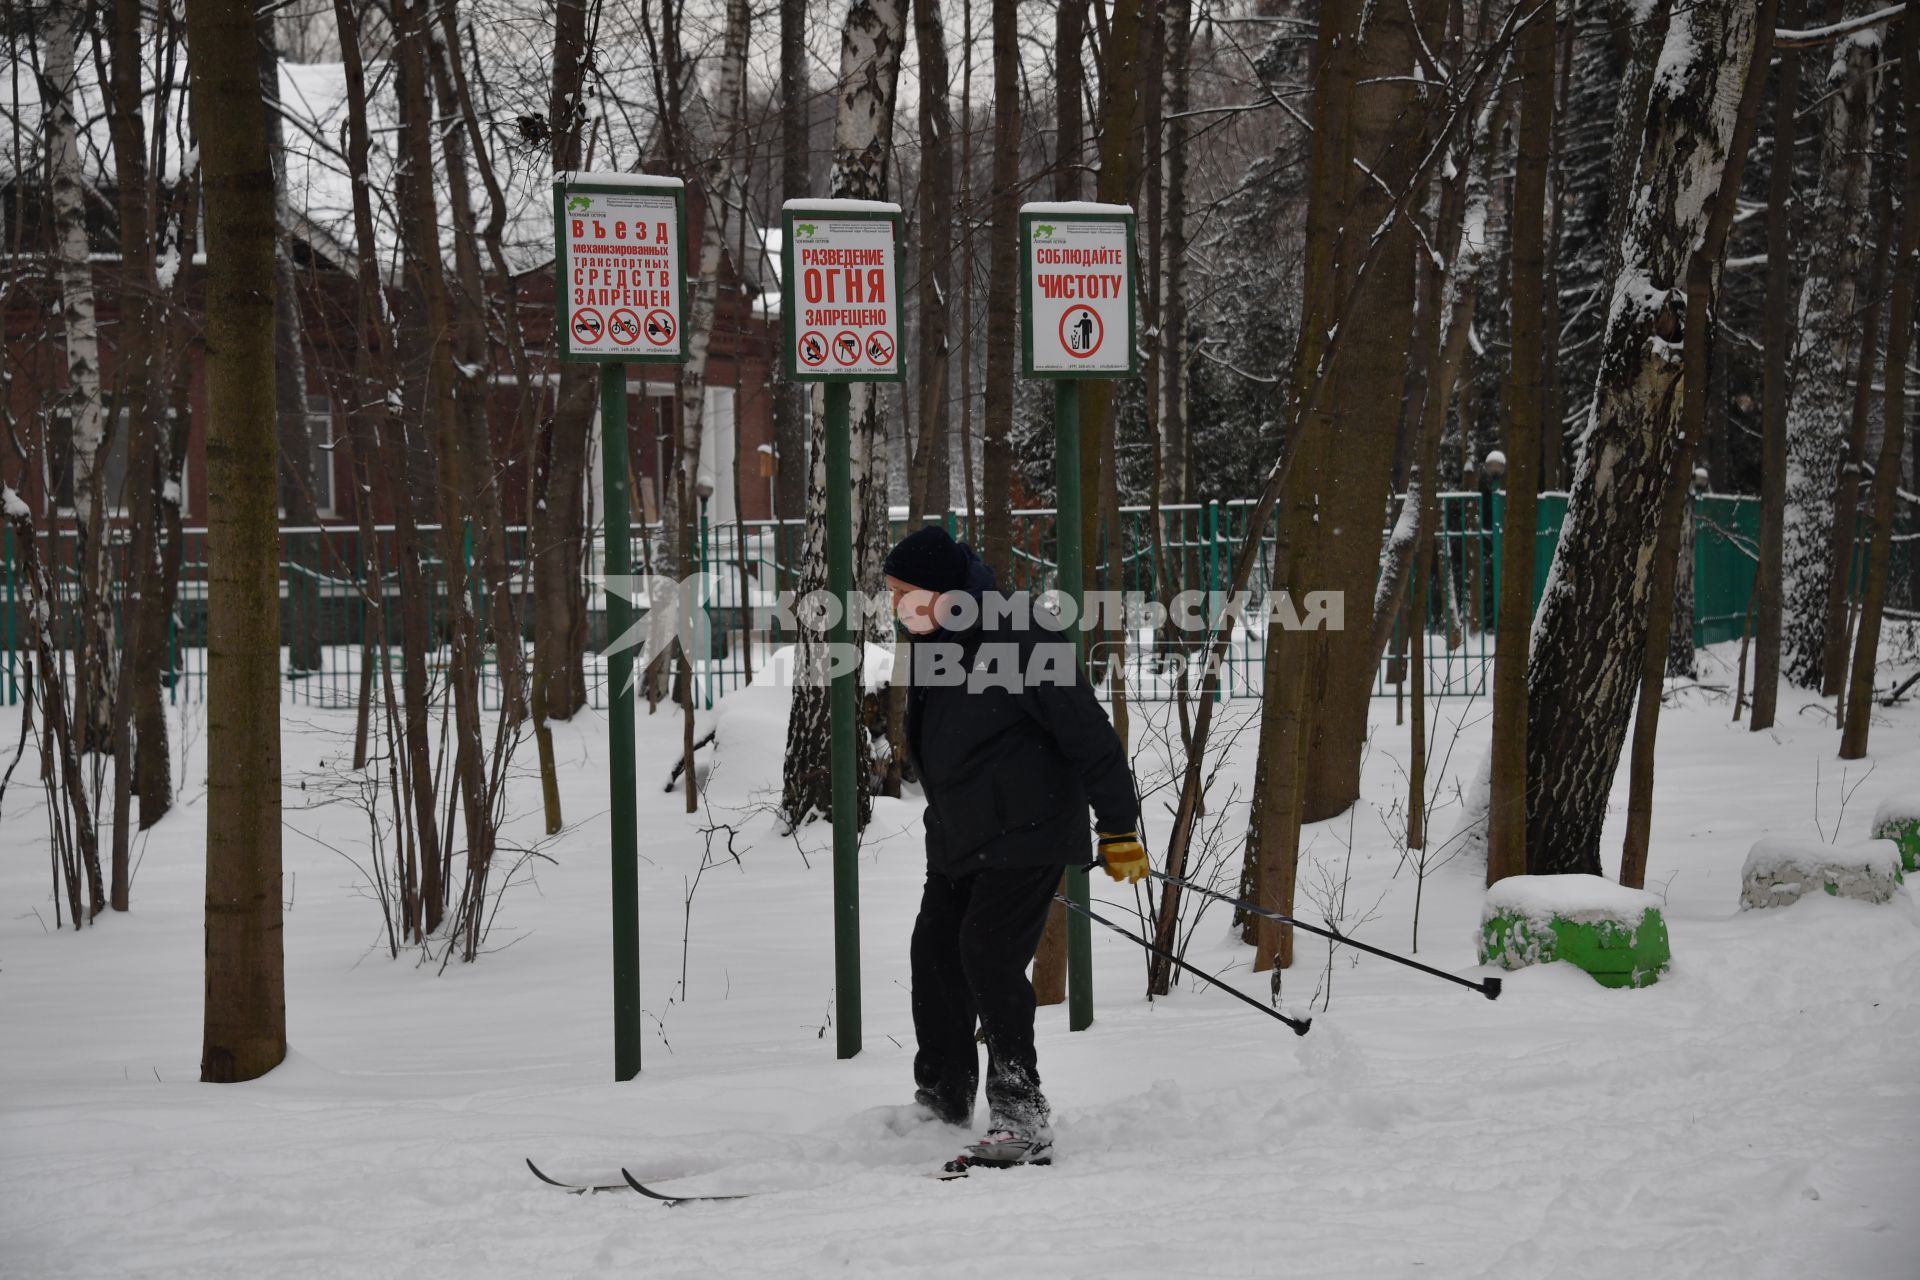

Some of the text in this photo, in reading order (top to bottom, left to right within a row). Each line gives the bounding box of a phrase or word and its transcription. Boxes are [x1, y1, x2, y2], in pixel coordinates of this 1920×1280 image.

[573, 243, 669, 257] механизированных
[802, 248, 884, 268] РАЗВЕДЕНИЕ
[1036, 246, 1122, 267] СОБЛЮДАЙТЕ
[574, 256, 669, 270] транспортных
[574, 268, 670, 289] СРЕДСТВ
[803, 268, 885, 304] ОГНЯ
[1037, 274, 1122, 299] ЧИСТОТУ
[574, 288, 670, 310] ЗАПРЕЩЕН
[805, 309, 887, 329] ЗАПРЕЩЕНО
